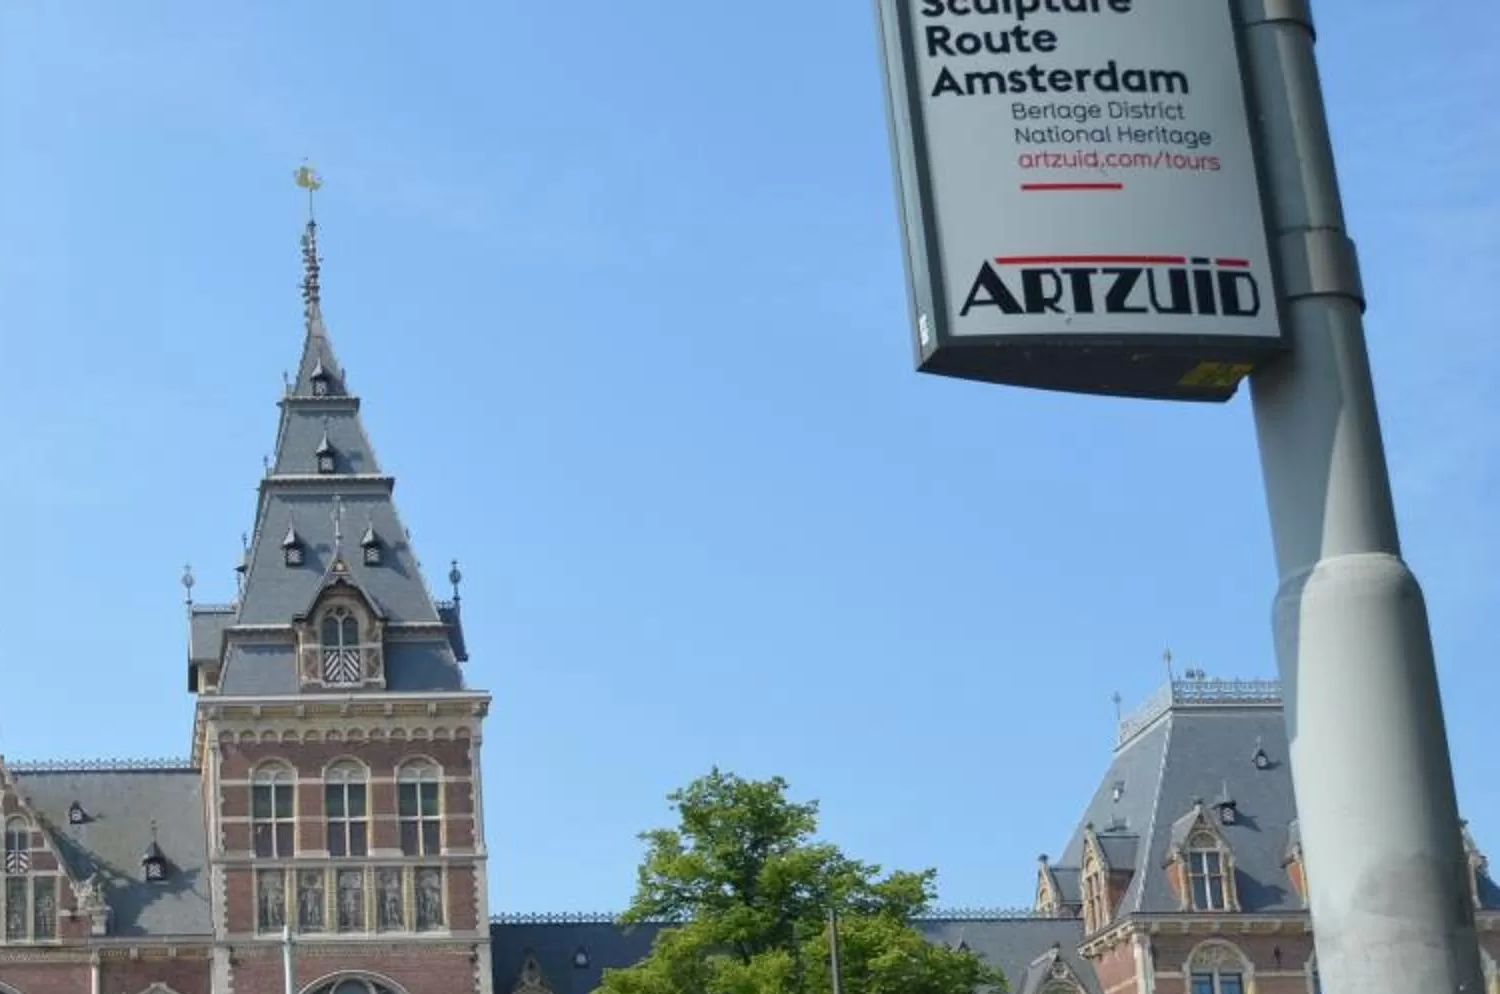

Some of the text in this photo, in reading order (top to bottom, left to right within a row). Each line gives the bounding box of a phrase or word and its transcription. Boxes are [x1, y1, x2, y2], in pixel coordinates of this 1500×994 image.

[925, 25, 1058, 57] Route
[931, 60, 1189, 97] Amsterdam
[1011, 101, 1186, 123] Berlage District
[1014, 125, 1212, 149] National Heritage
